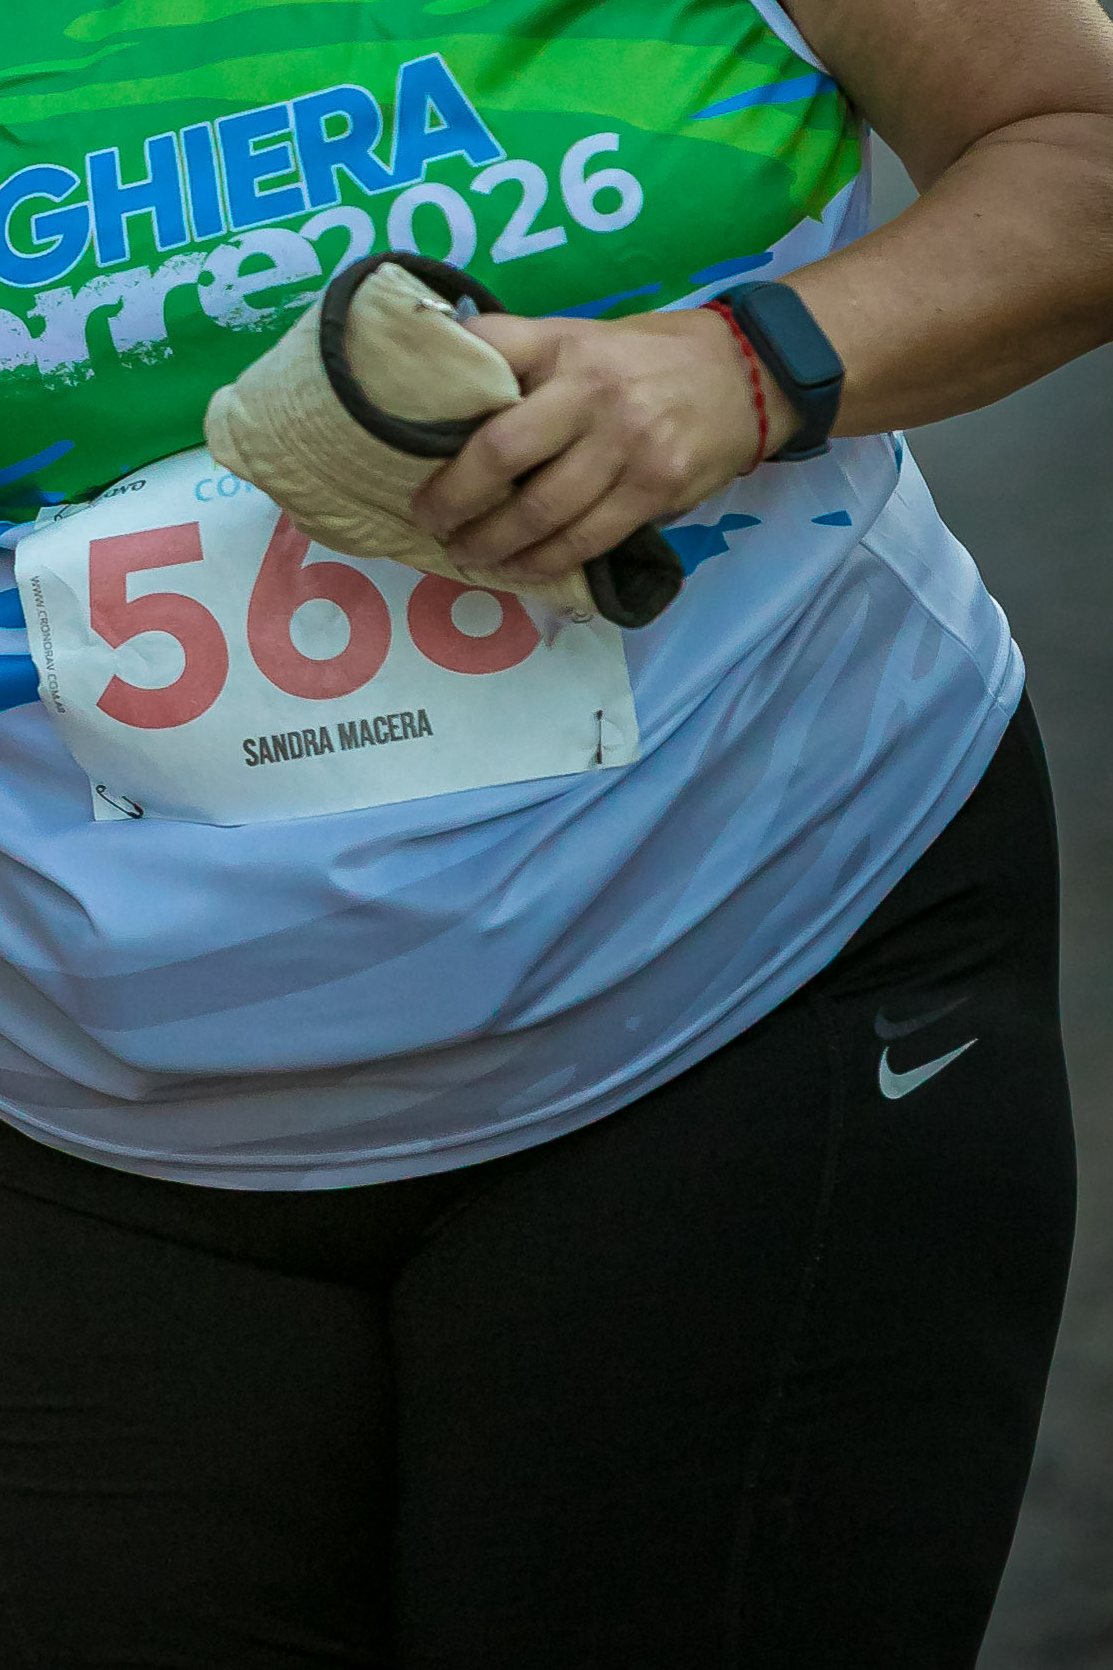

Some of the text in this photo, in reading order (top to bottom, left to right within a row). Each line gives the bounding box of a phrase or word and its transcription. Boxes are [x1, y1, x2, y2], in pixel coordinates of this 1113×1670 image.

[299, 131, 645, 286] 2026
[89, 513, 540, 730] 568
[242, 708, 435, 766] SANDRA MACERA
